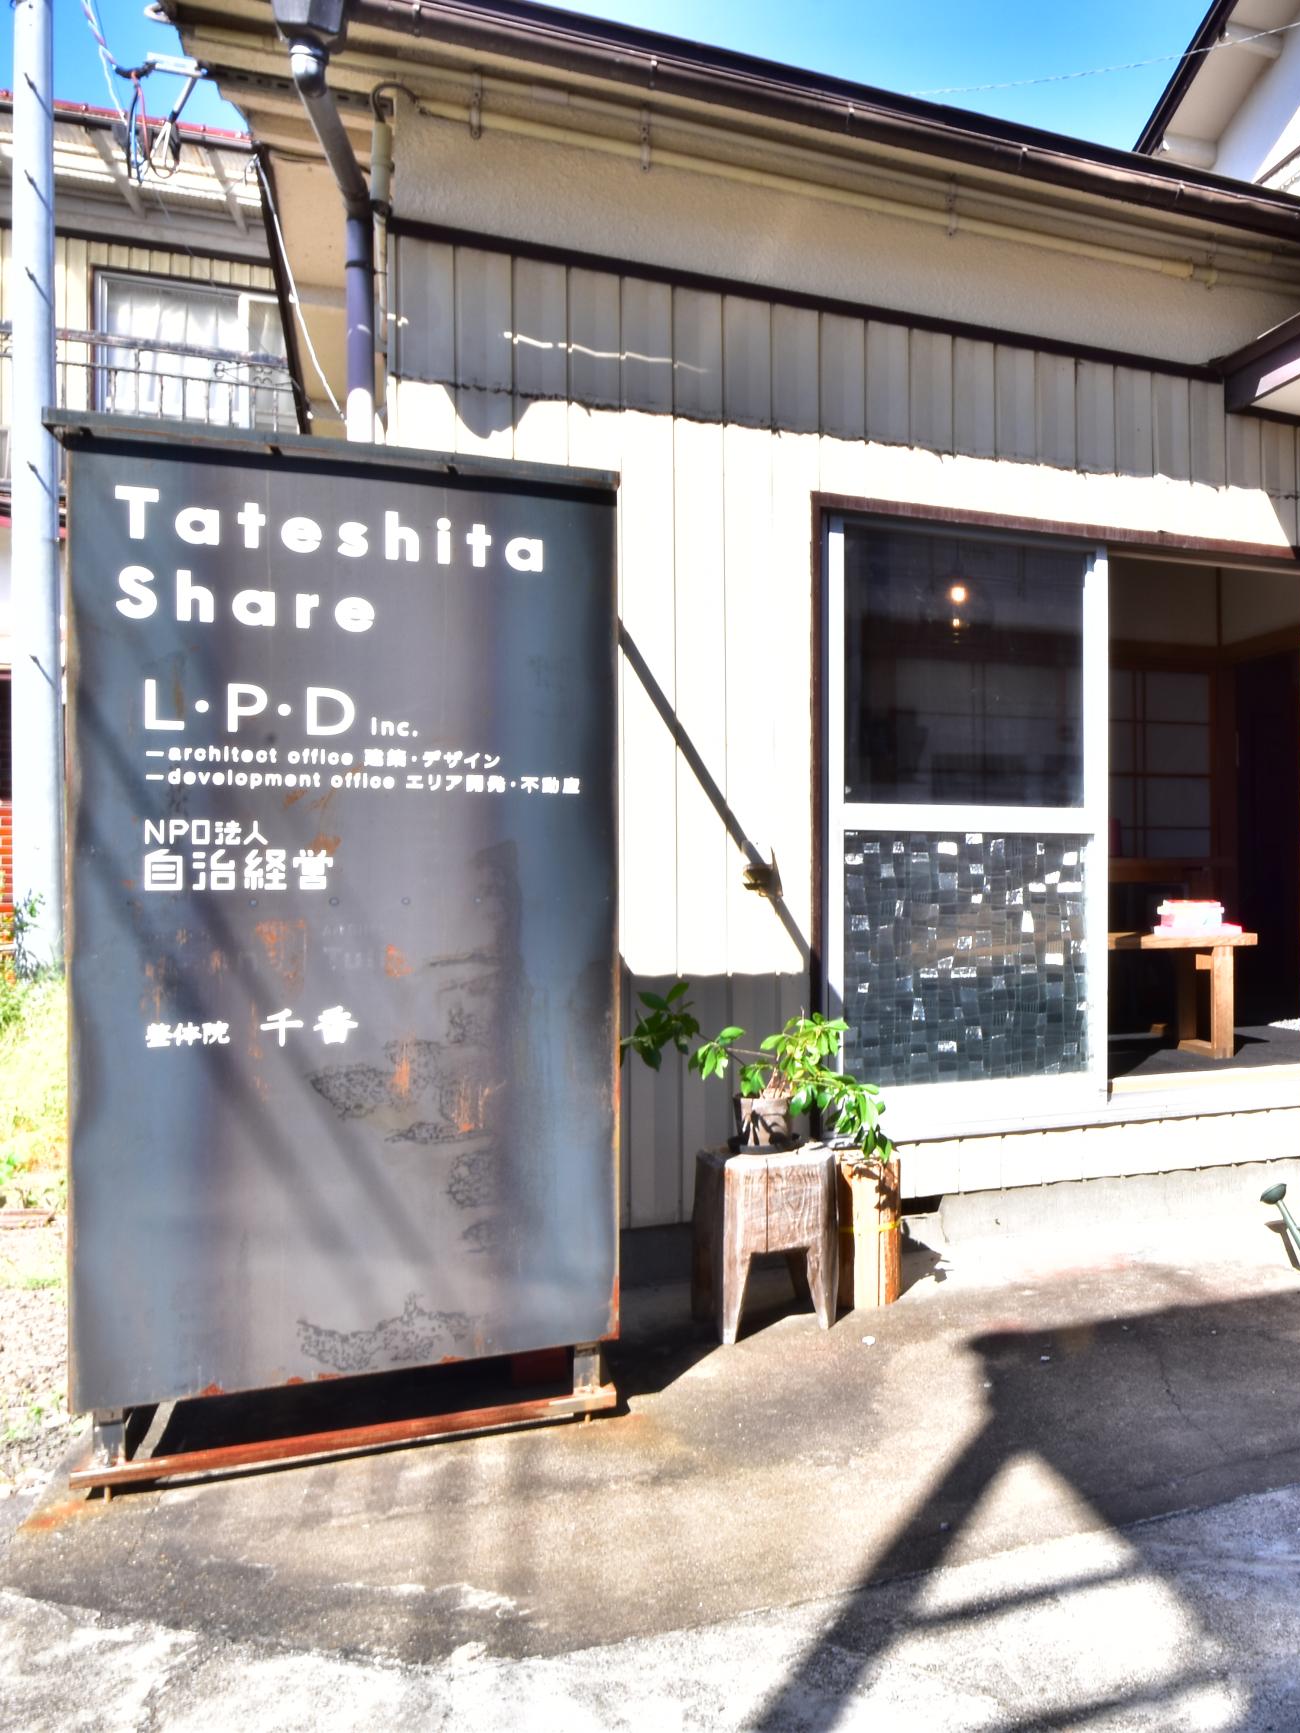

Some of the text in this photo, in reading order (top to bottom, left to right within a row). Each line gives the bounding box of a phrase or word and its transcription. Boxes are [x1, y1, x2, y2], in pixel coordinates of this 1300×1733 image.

[114, 484, 545, 573] Tateshita
[115, 565, 376, 633] Share
[287, 748, 354, 766] office
[330, 771, 396, 790] office
[144, 819, 269, 846] NPO法人
[144, 849, 334, 892] 自治経営
[145, 1020, 230, 1049] 整体院
